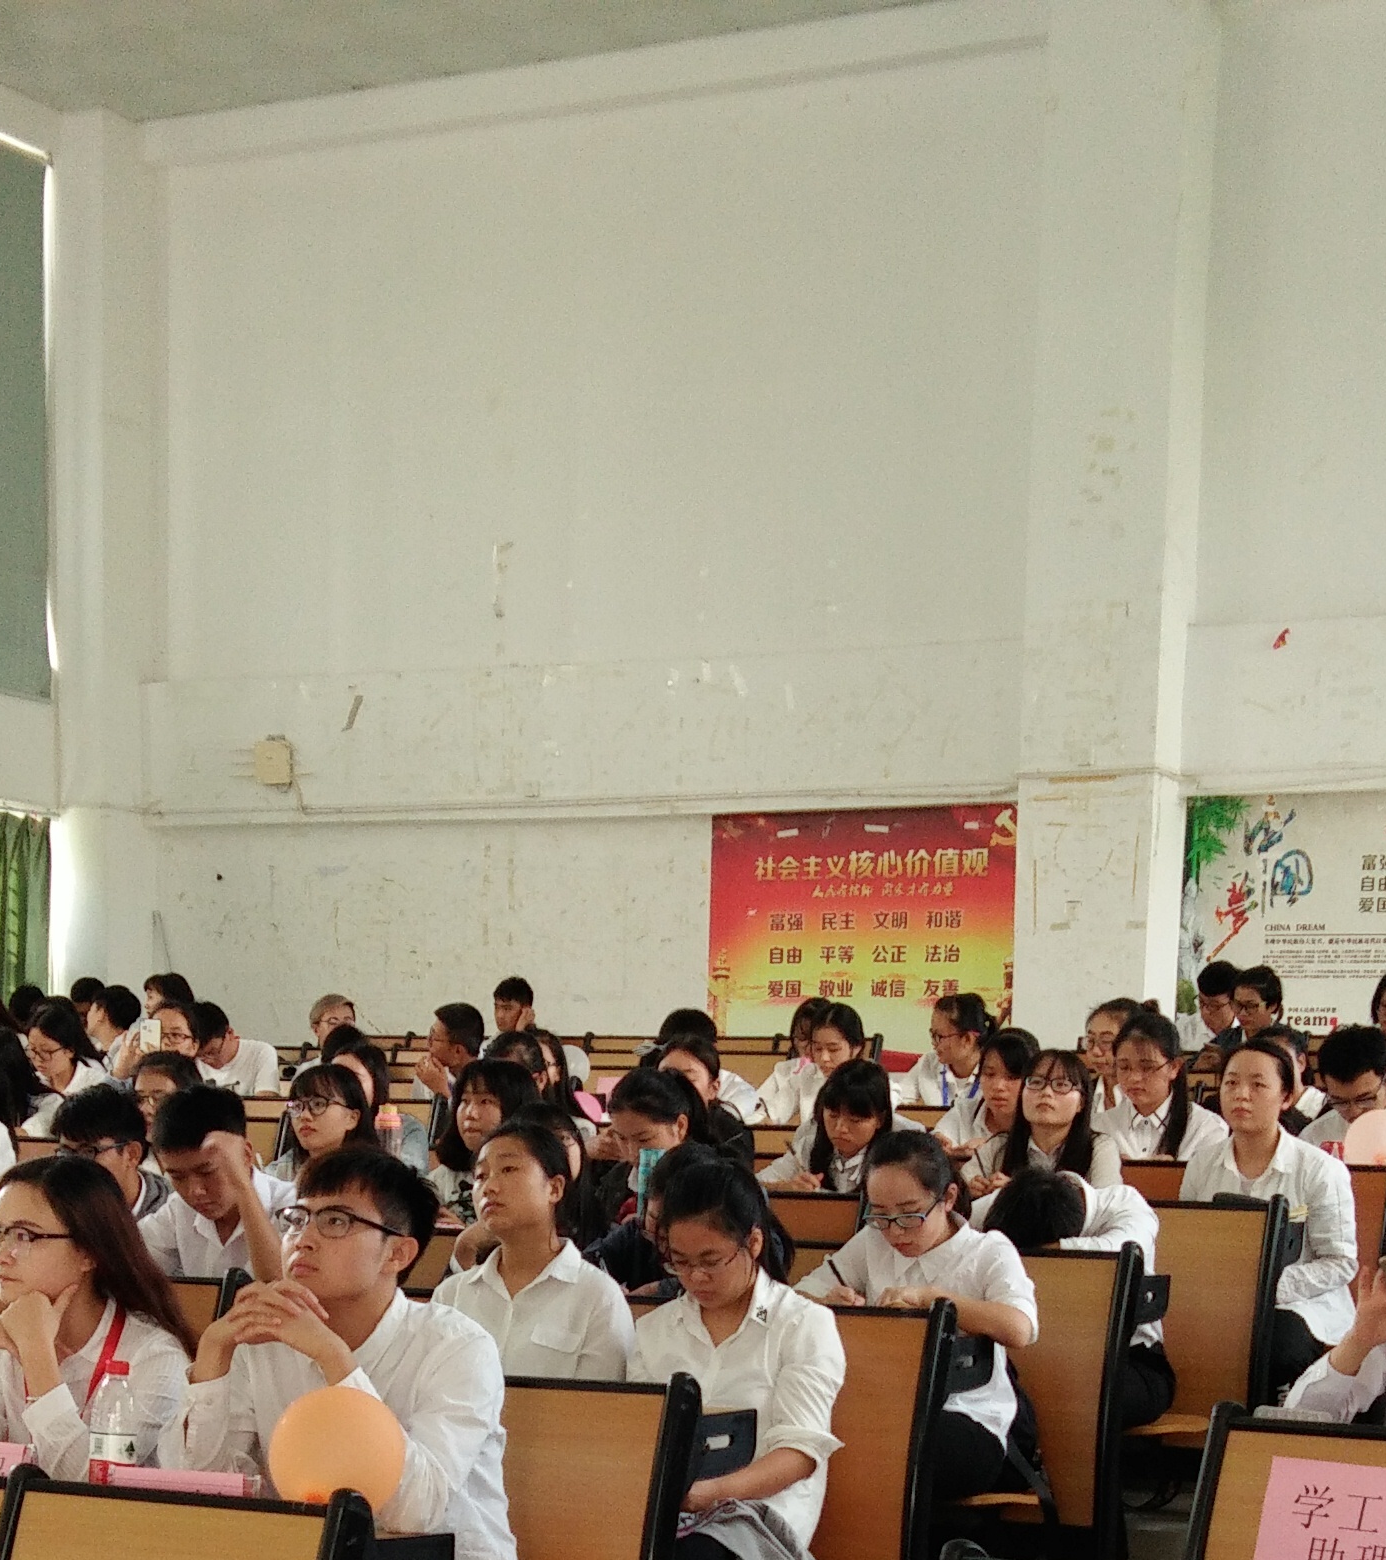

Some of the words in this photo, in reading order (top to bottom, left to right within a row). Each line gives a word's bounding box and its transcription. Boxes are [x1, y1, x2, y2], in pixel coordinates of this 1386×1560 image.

[754, 847, 989, 881] 社会主义核心价值观
[769, 912, 804, 931] 富强
[821, 911, 855, 931] 民主
[872, 910, 908, 930] 文明
[925, 909, 962, 929] 和谐
[1264, 924, 1291, 932] CHINA
[1296, 923, 1326, 931] DREAM
[769, 946, 802, 965] 自由
[819, 945, 855, 965] 平等
[871, 944, 907, 963] 公正
[924, 943, 960, 963] 法治
[767, 979, 801, 998] 爱国
[819, 978, 853, 998] 敬业
[871, 978, 906, 997] 诚信
[923, 978, 959, 997] 友善
